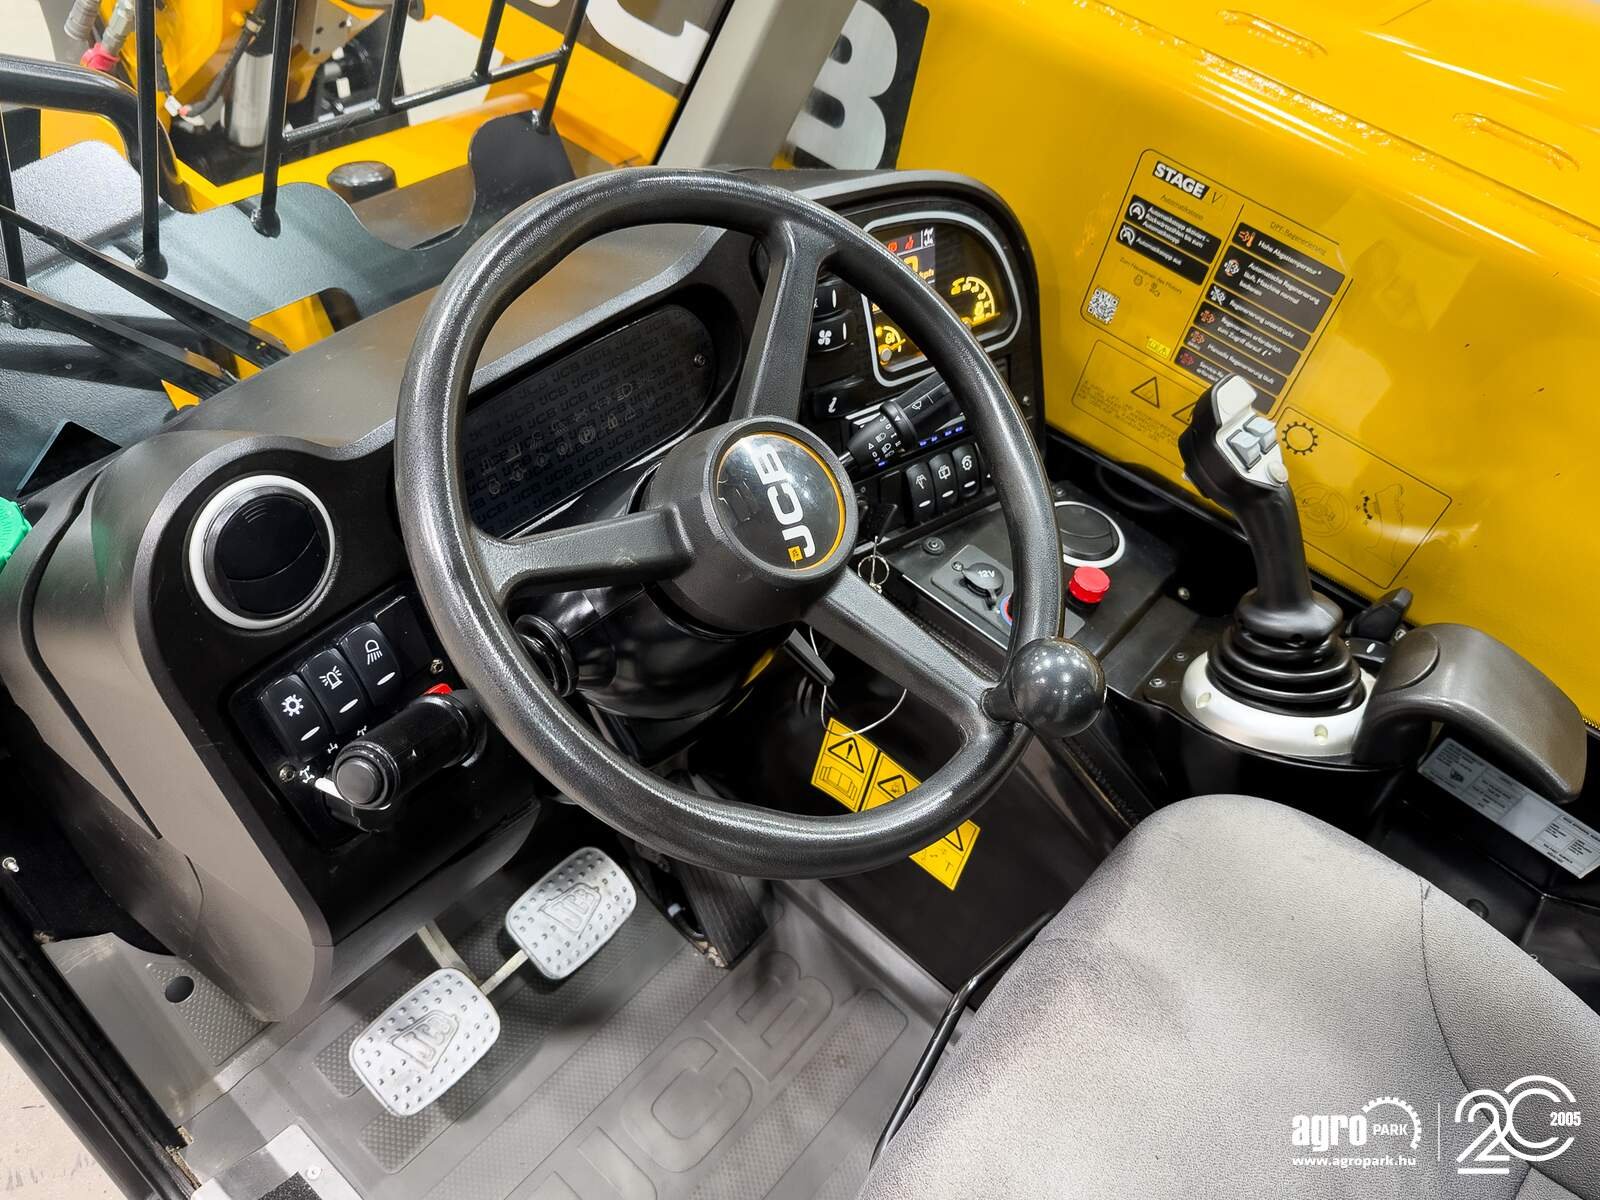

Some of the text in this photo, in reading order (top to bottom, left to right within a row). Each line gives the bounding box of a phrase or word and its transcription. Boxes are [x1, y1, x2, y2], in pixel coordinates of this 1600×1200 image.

[1155, 163, 1223, 204] STAGE V
[1258, 240, 1273, 253] Hohe
[1248, 263, 1320, 305] Automatische Regenerierung
[1256, 278, 1280, 294] Maschine
[1280, 291, 1300, 305] normal
[1229, 300, 1264, 325] Regenerierung
[1229, 356, 1264, 379] Regenerierung
[751, 444, 816, 558] JCB
[977, 569, 996, 578] 12V
[554, 891, 594, 930] JCB
[395, 1015, 451, 1063] JCB
